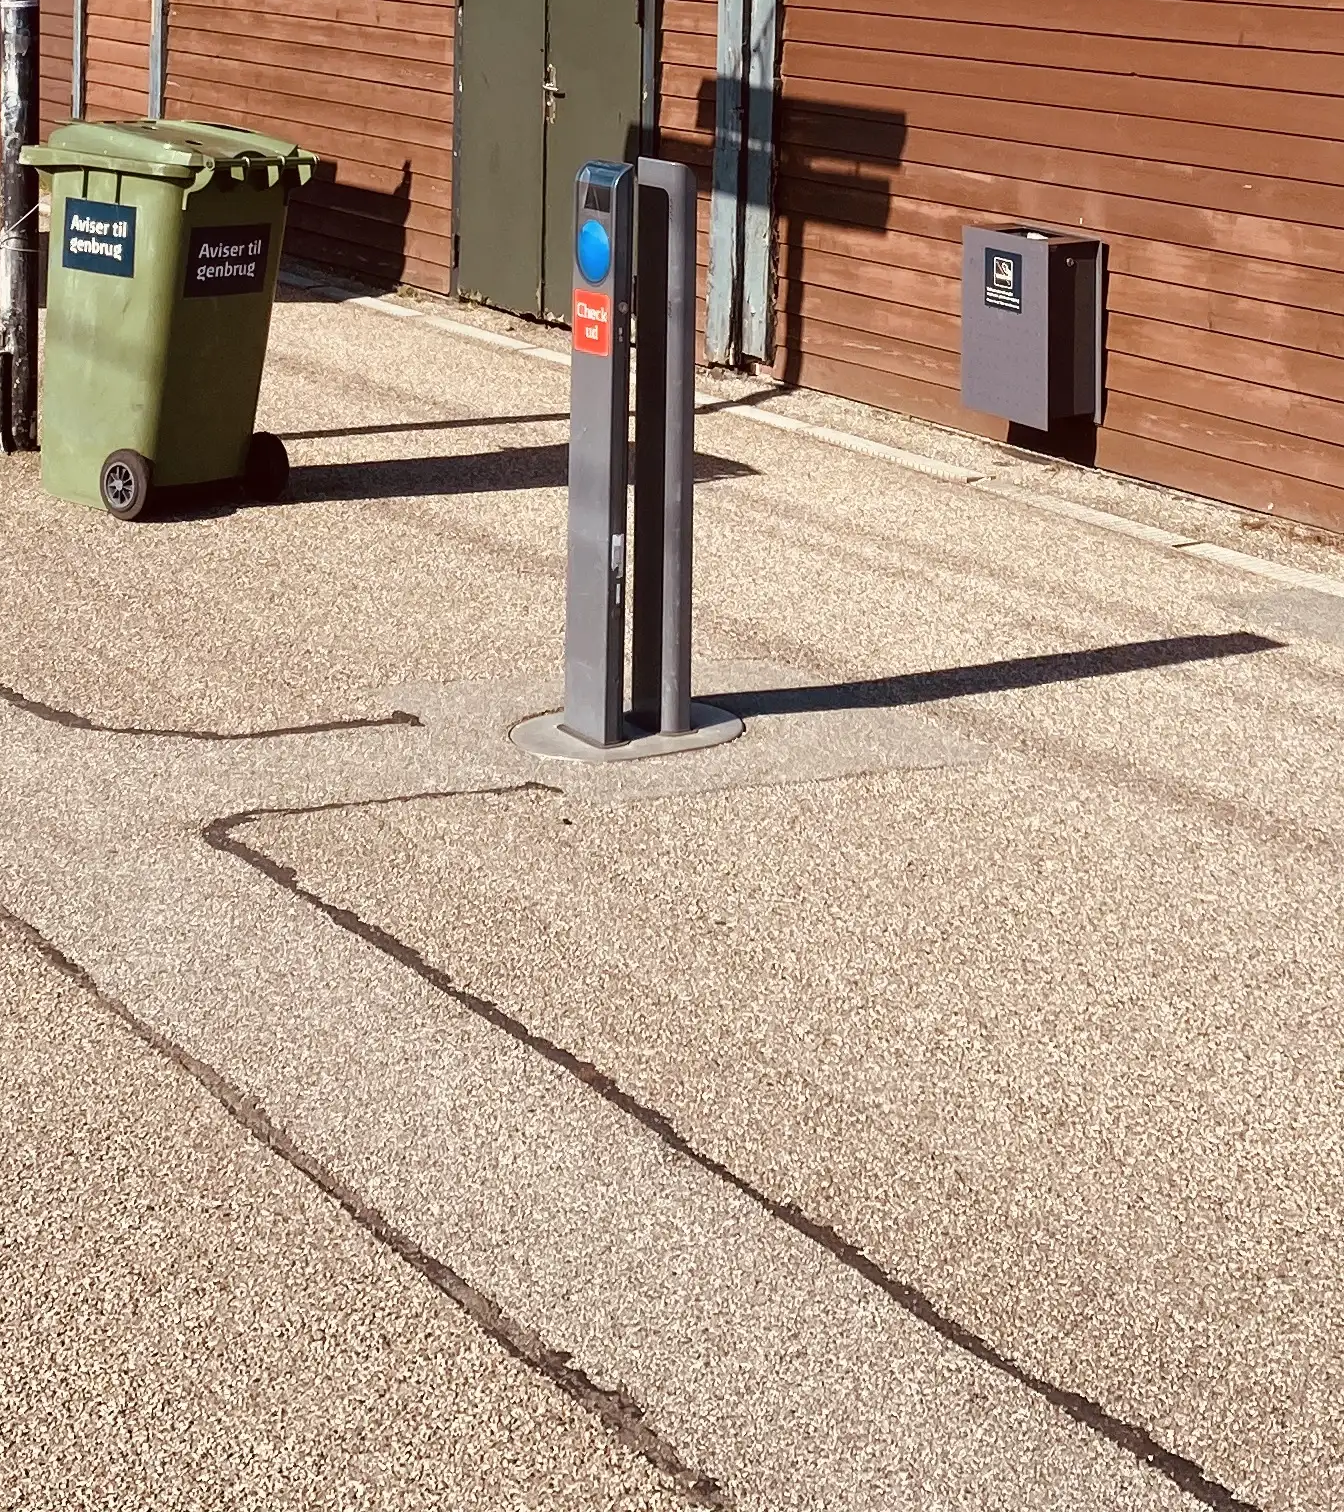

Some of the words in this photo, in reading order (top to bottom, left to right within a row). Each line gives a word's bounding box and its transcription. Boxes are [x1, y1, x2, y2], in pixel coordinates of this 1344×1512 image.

[70, 214, 110, 236] Aviser
[112, 220, 128, 239] til
[69, 237, 123, 262] genbrug
[198, 243, 244, 259] Aviser
[247, 239, 262, 256] til
[196, 261, 256, 282] genbrug
[577, 301, 608, 323] Check
[585, 324, 599, 341] ud
